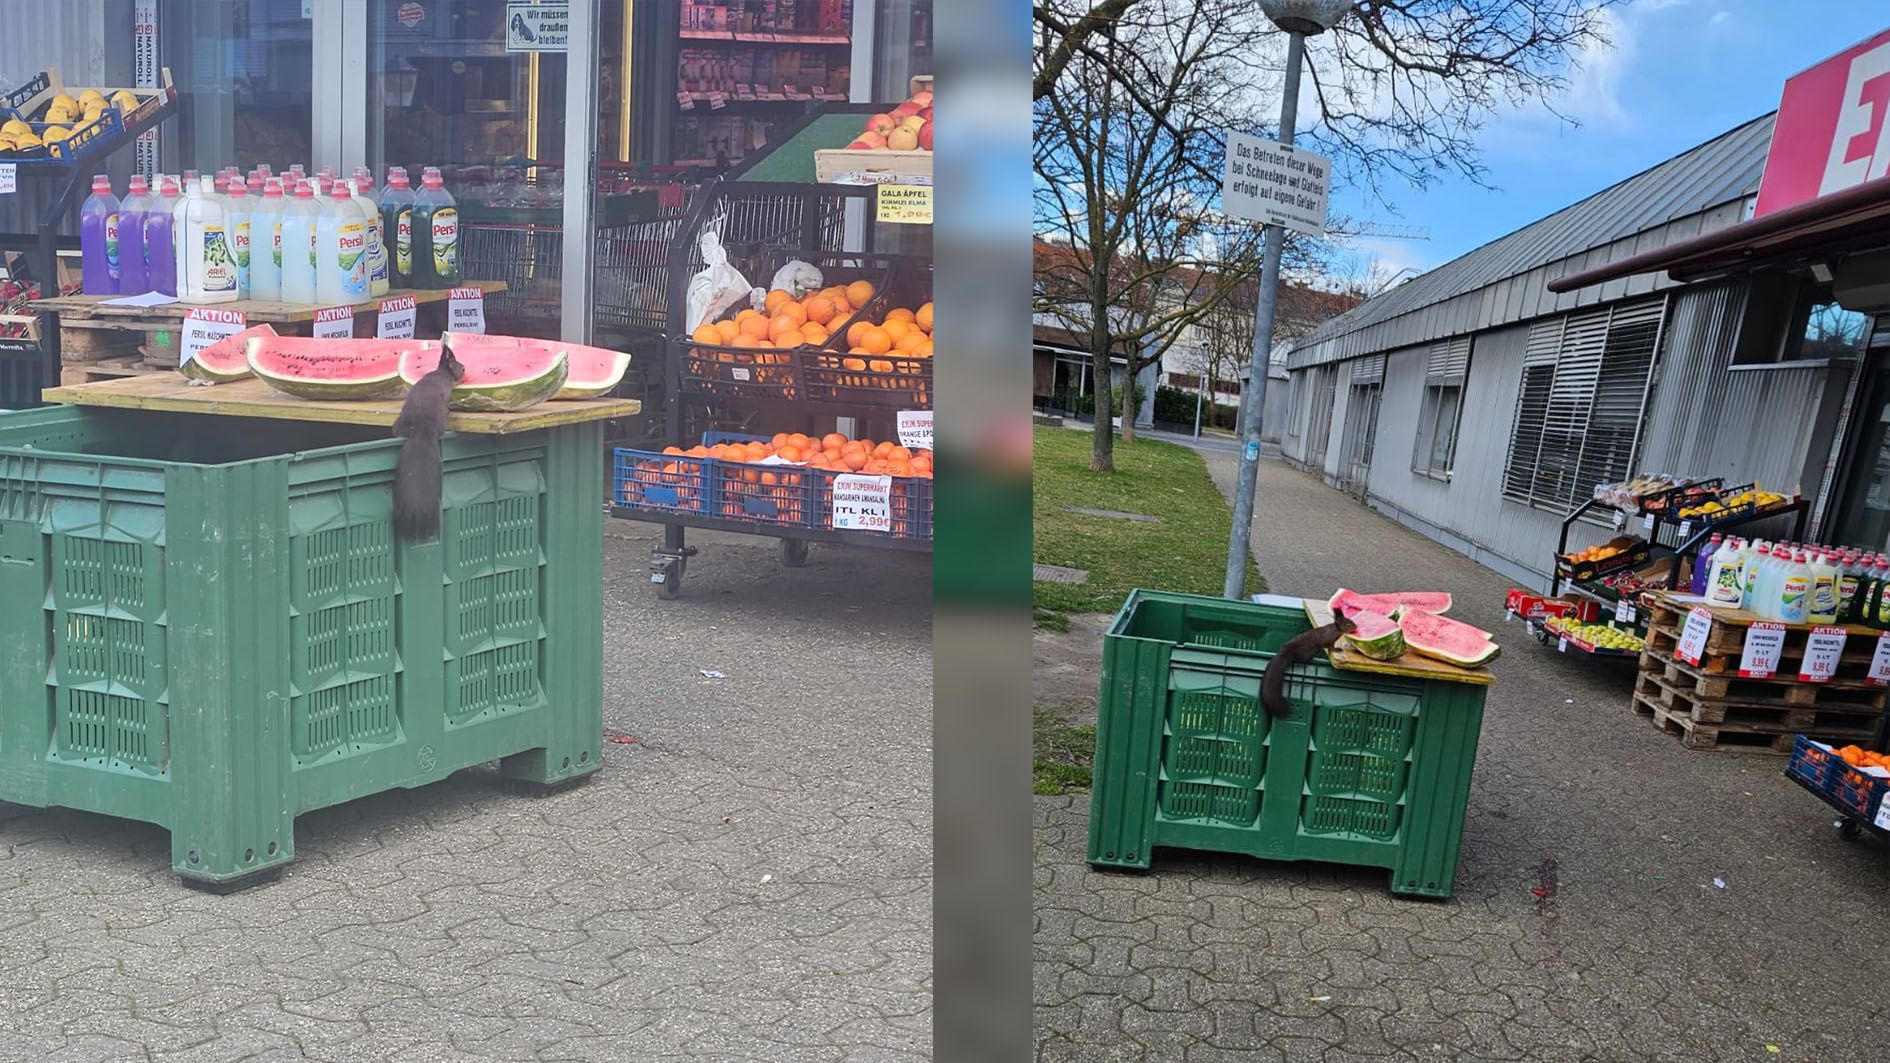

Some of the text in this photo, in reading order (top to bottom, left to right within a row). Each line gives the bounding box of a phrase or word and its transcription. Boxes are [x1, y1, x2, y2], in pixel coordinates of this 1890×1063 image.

[527, 9, 568, 19] Wir müssen
[540, 22, 568, 32] draußen
[1237, 143, 1324, 179] Das Betreten dieser Wege
[1232, 160, 1244, 174] bei
[1246, 163, 1287, 185] Schneelage
[1233, 180, 1258, 198] erfolgt
[1260, 186, 1273, 199] auf
[1274, 189, 1295, 205] eigene
[1297, 194, 1317, 211] Gefahr
[339, 235, 364, 249] Persil
[207, 268, 227, 276] ARIEL
[451, 288, 481, 299] AKTION
[381, 297, 415, 313] AKTION
[190, 308, 243, 324] AKTION
[317, 306, 352, 322] AKTION
[836, 506, 857, 514] ITL
[858, 516, 890, 526] 2,99€
[1785, 583, 1805, 592] Persil
[1751, 622, 1785, 630] AKTION
[1813, 627, 1847, 635] AKTION
